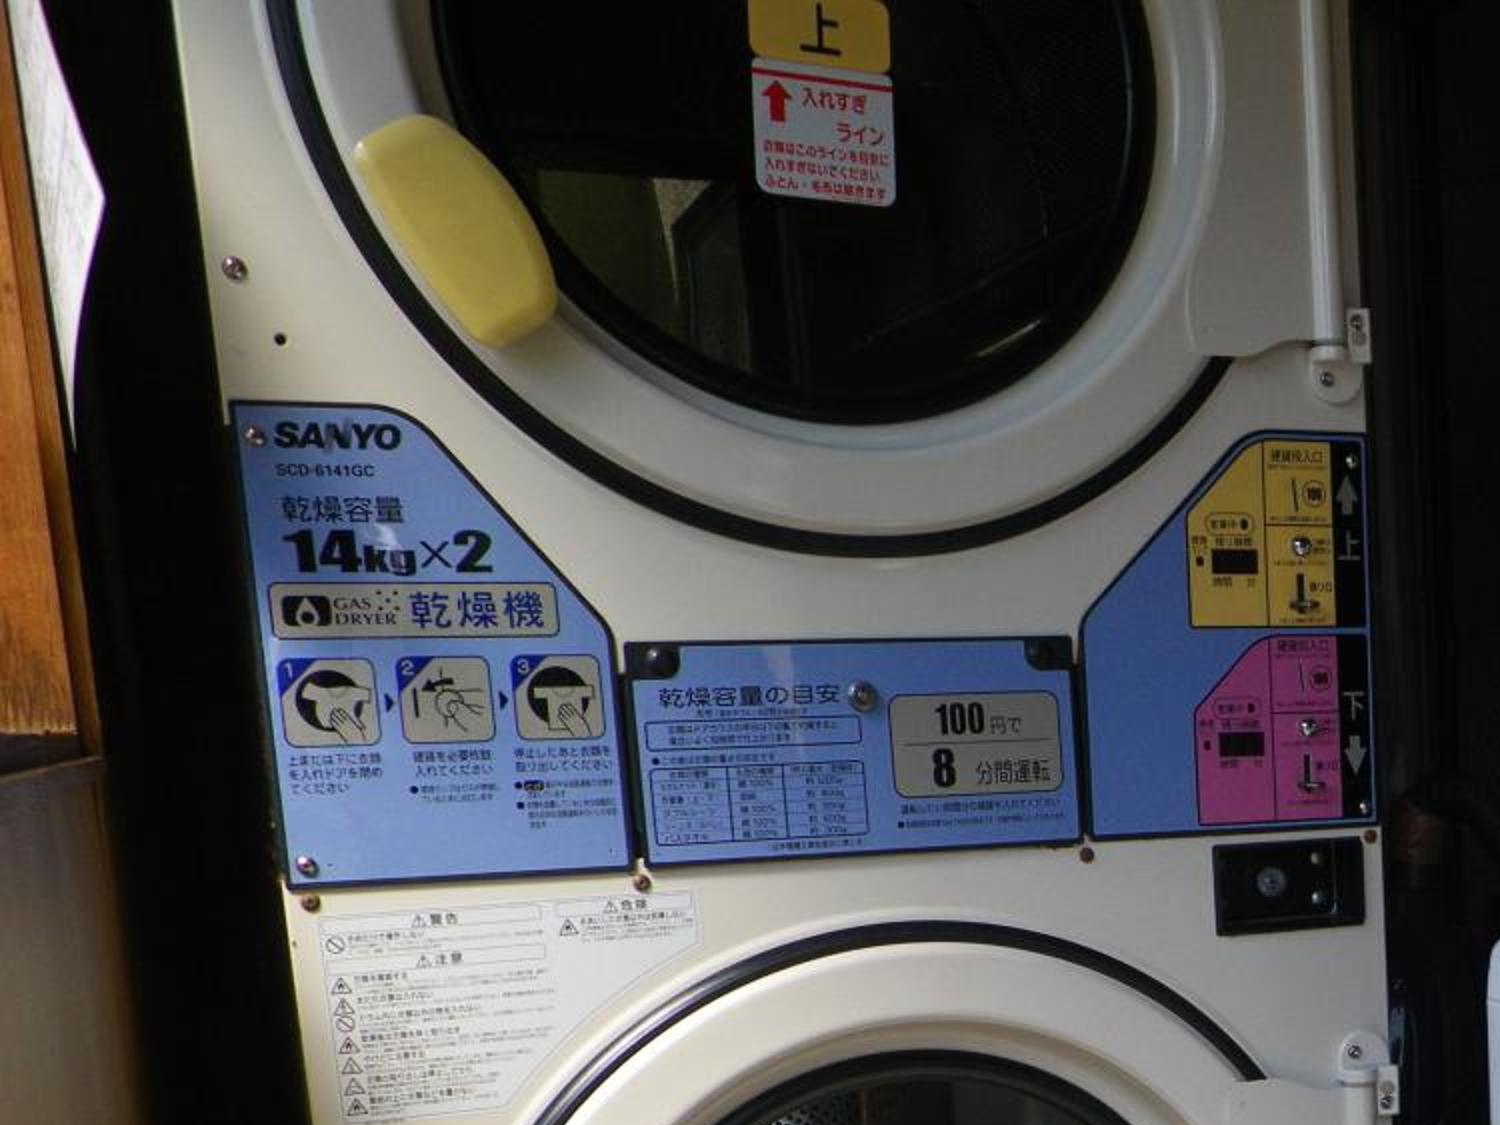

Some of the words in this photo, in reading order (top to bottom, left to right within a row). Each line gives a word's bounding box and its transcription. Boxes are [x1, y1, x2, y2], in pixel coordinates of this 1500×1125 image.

[799, 3, 841, 56] 上
[801, 87, 866, 114] 入れすぎ
[836, 123, 884, 146] ライン
[274, 421, 401, 450] SANYO
[276, 463, 375, 478] SCD-6141GC
[282, 495, 405, 524] 乾燥容量
[1337, 530, 1361, 561] 上
[333, 598, 372, 610] GAS
[408, 591, 546, 629] 乾燥機
[335, 611, 397, 626] DRYER
[284, 662, 294, 678] 1
[401, 659, 412, 675] 2
[517, 658, 529, 674] 3
[658, 684, 840, 708] 乾燥容量の目安
[1343, 690, 1365, 721] 下
[935, 702, 985, 735] 100
[932, 748, 956, 788] 8
[975, 758, 1050, 785] 分間運転
